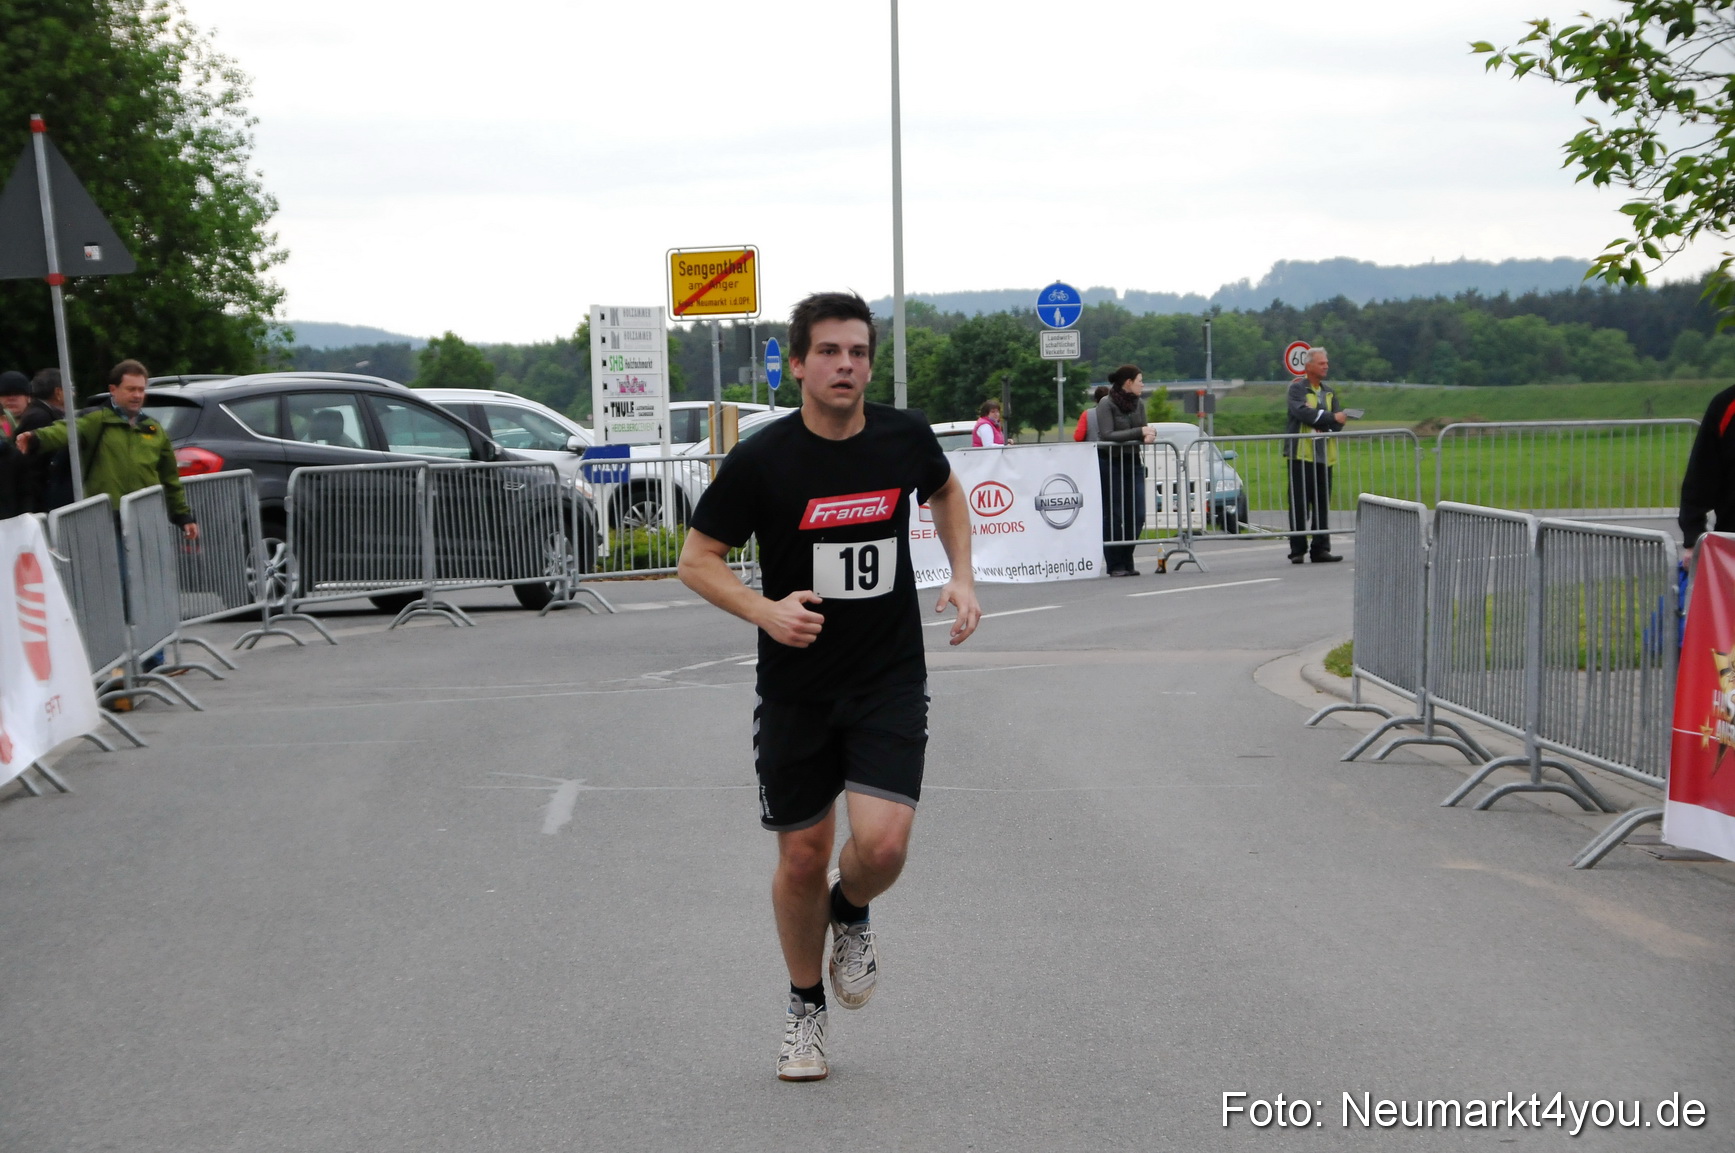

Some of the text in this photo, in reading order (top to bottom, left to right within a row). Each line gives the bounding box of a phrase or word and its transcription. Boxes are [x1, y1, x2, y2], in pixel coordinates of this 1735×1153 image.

[678, 258, 748, 280] Sengenthal
[708, 280, 739, 292] Anger
[697, 298, 727, 307] Neumarkt
[1291, 351, 1307, 367] 60
[610, 401, 634, 417] THULE
[977, 490, 1005, 509] KIA
[1040, 496, 1079, 507] NISSAN
[809, 496, 889, 523] Franek
[910, 529, 938, 539] SE
[980, 521, 1025, 535] MOTORS
[839, 544, 879, 591] 19
